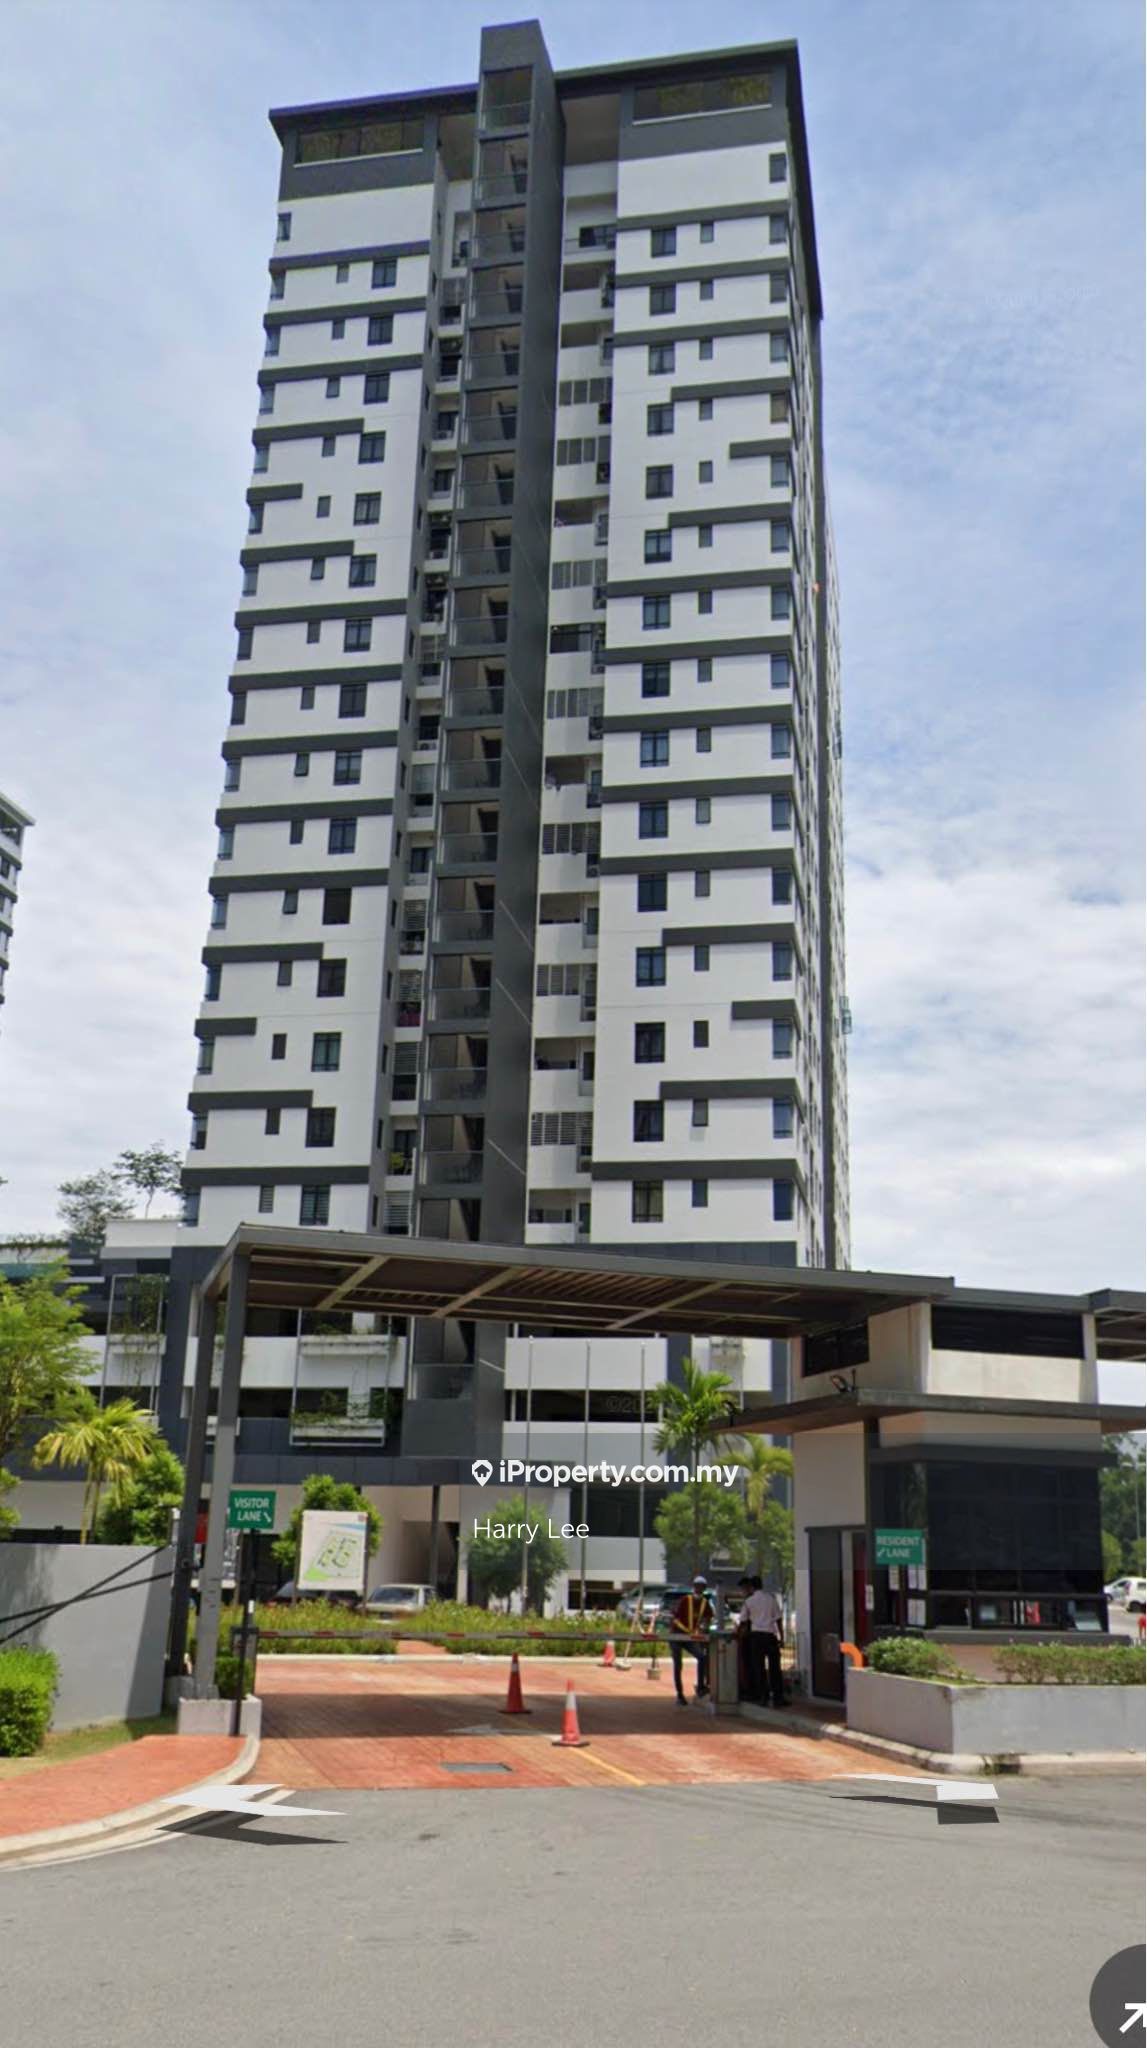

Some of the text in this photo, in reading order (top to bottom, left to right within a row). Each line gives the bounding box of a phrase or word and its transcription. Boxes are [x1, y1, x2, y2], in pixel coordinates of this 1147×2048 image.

[234, 1497, 270, 1508] VISITOR
[237, 1511, 261, 1521] LANE
[876, 1535, 920, 1546] RESIDENT
[887, 1548, 911, 1558] LANE
